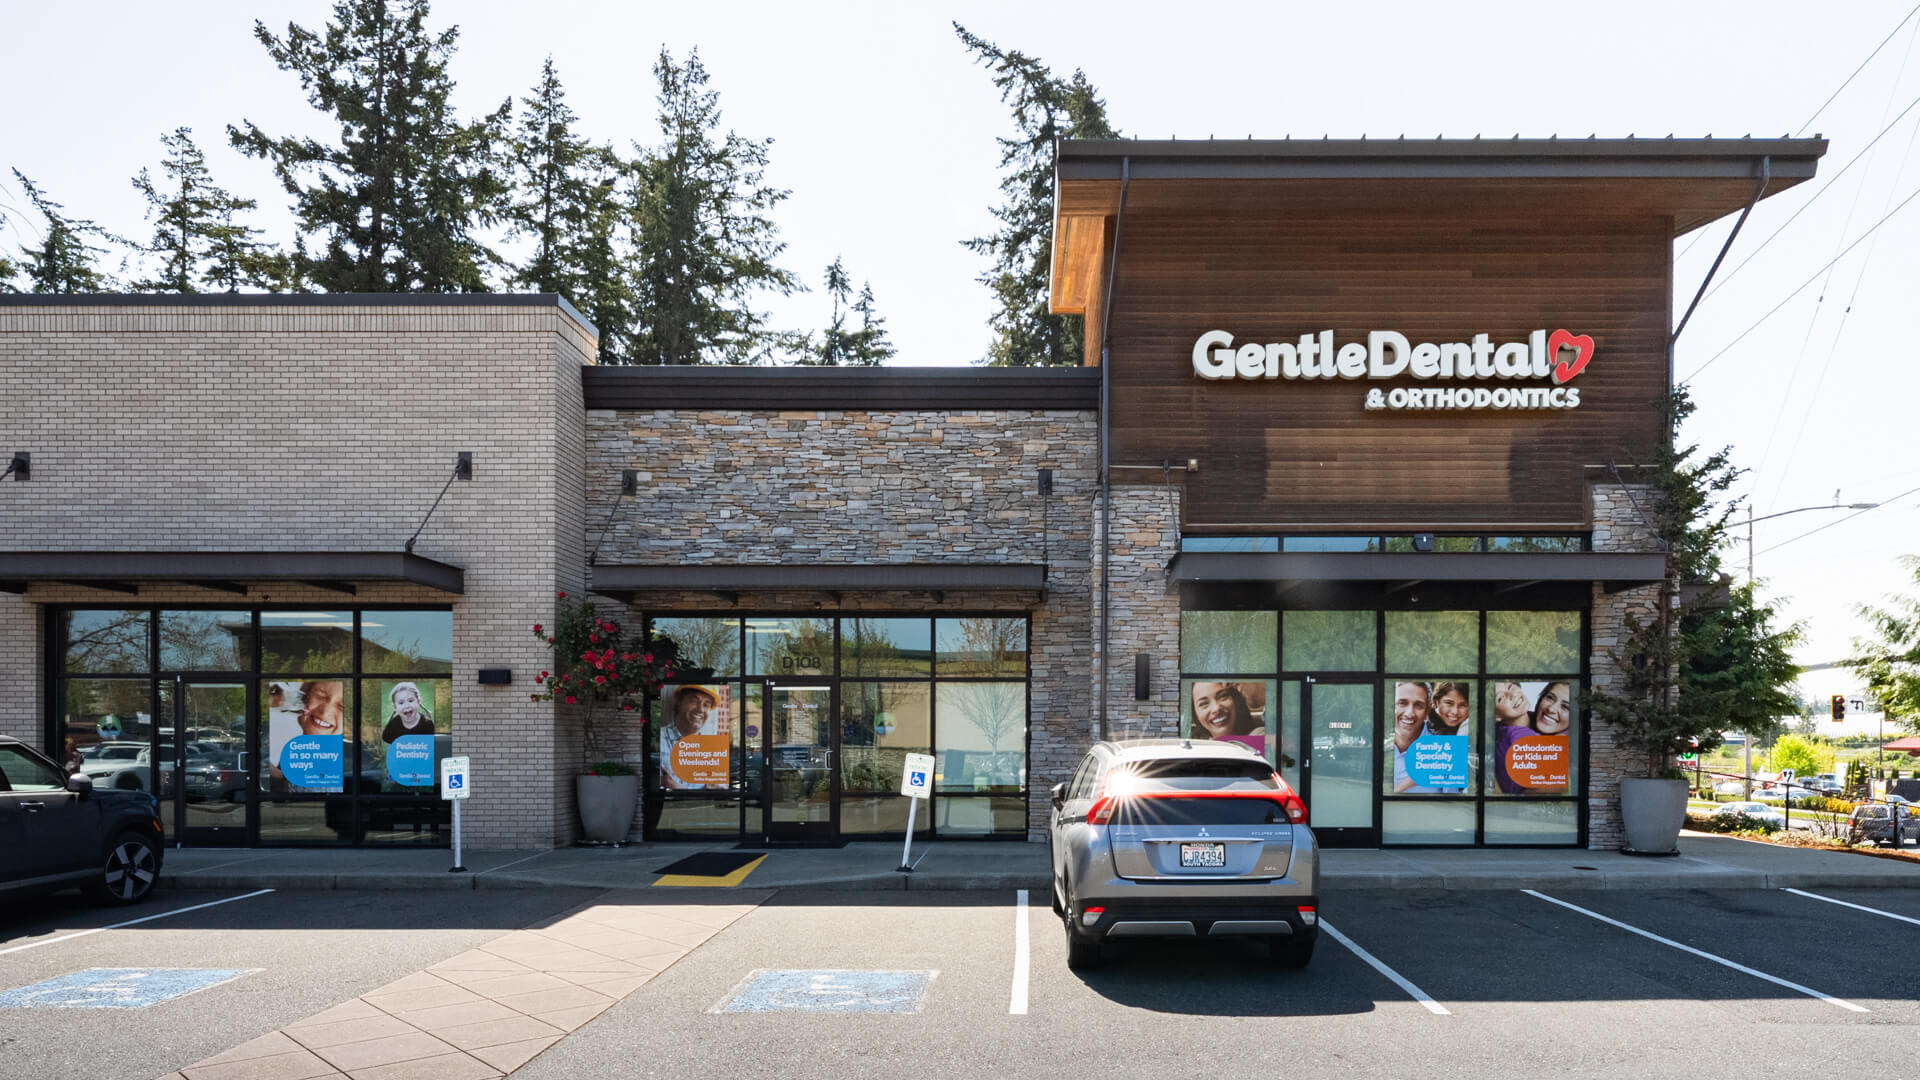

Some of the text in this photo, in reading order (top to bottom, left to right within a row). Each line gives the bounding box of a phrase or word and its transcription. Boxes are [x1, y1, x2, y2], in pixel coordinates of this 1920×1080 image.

[1365, 388, 1581, 409] & ORTHODONTICS
[782, 656, 822, 669] D108
[289, 741, 320, 750] Gentle
[396, 742, 428, 750] Pediatric
[679, 741, 700, 750] Open
[1416, 742, 1451, 752] Family &
[1512, 744, 1562, 752] Orthodontics
[289, 751, 339, 762] in so many
[396, 750, 429, 760] Dentistry
[679, 749, 728, 759] Evenings and
[1416, 751, 1453, 762] Specialty
[1512, 752, 1558, 760] for Kids and
[289, 761, 314, 771] ways
[679, 758, 720, 766] Weekends!
[1416, 761, 1454, 772] Dentistry
[1512, 761, 1538, 769] Adults
